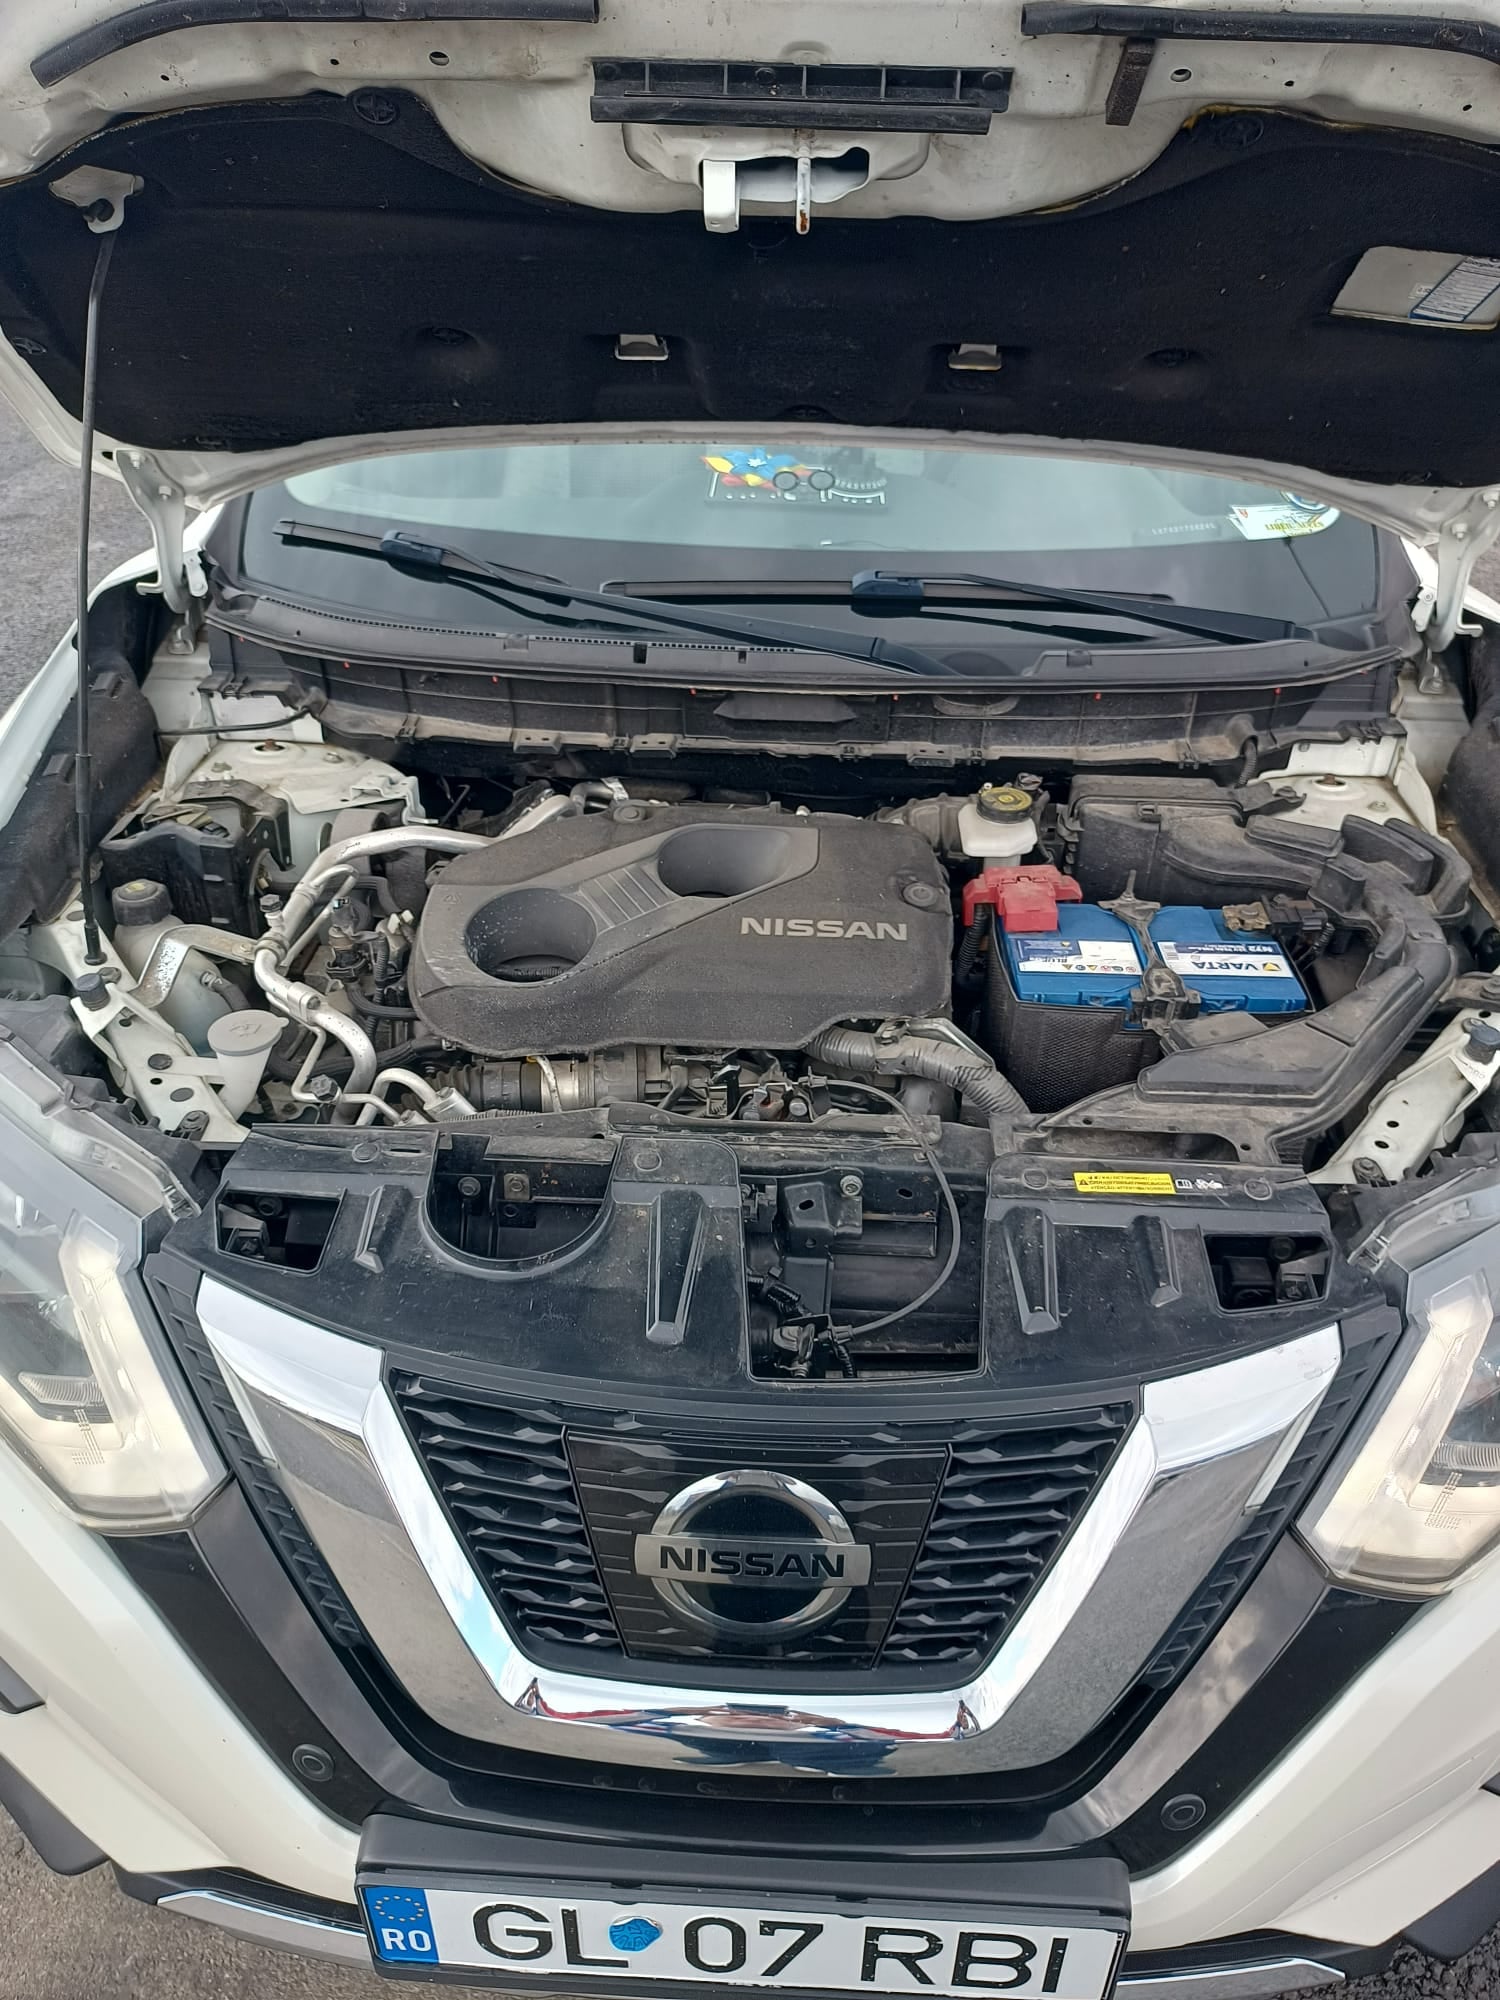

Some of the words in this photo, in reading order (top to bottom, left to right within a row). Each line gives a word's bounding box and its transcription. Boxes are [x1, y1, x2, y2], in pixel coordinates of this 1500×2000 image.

[740, 916, 908, 941] NISSAN
[1191, 960, 1260, 971] VARTA
[659, 1545, 845, 1578] NISSAN
[381, 1927, 433, 1952] RO
[472, 1903, 629, 1969] GL
[684, 1916, 823, 1976] 07
[860, 1926, 1070, 1993] RBI
